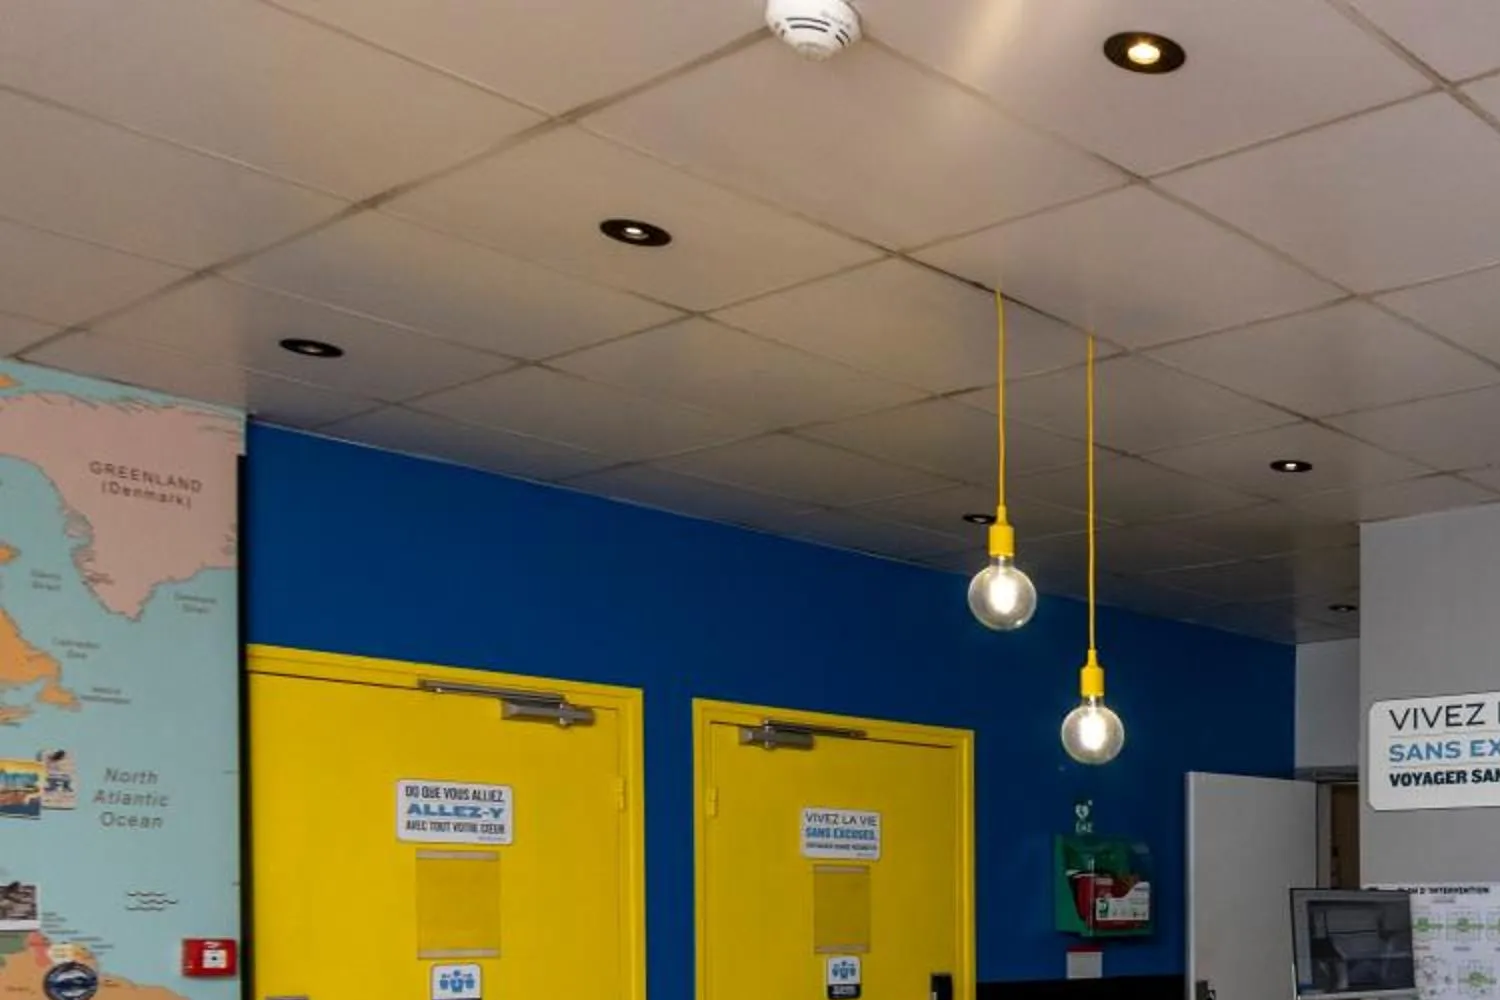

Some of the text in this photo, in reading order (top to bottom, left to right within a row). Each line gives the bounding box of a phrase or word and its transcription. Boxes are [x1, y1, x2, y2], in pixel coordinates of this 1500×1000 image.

[89, 461, 202, 493] GREENLAND
[1389, 702, 1485, 730] VIVEZ
[1389, 741, 1461, 763] SANS
[104, 768, 159, 785] North
[1389, 769, 1467, 787] VOYAGER
[93, 790, 170, 807] Atlantic
[443, 787, 469, 800] VOUS
[407, 803, 504, 818] ALLEZ-Y
[101, 812, 163, 828] Ocean
[806, 812, 877, 827] VIVEZ LA VIE
